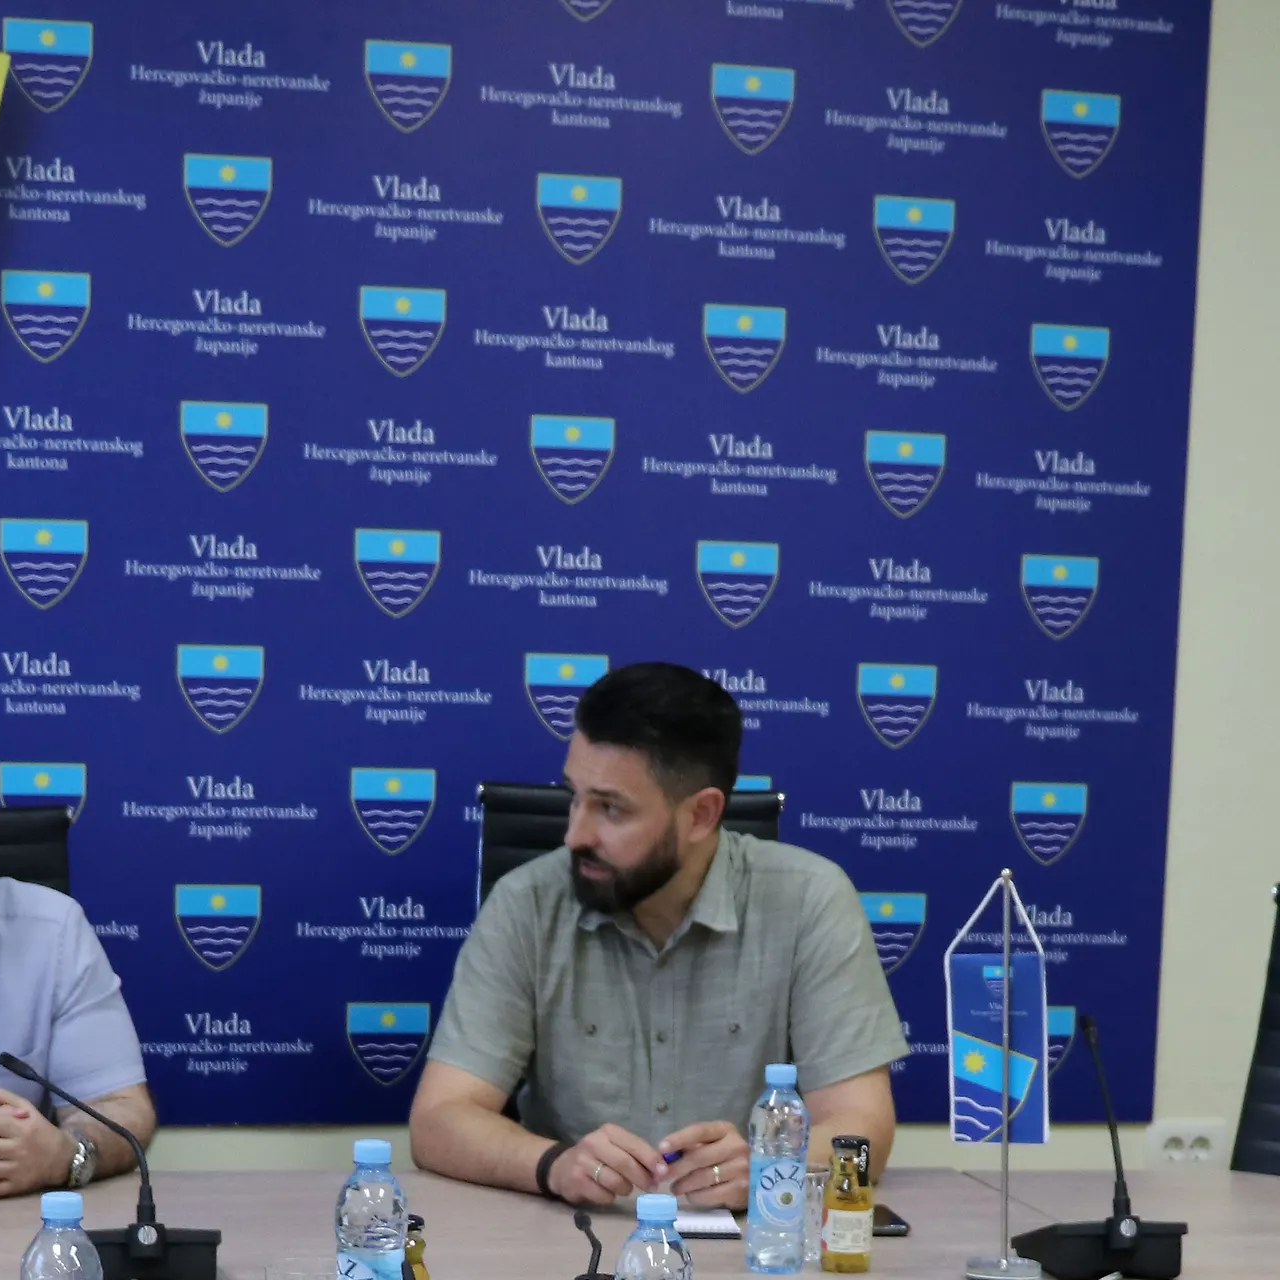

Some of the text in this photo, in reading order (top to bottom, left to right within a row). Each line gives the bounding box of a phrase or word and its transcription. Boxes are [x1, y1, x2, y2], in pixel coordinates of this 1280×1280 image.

[727, 0, 784, 20] kantona
[197, 41, 265, 67] Vlada
[131, 65, 330, 91] Hercegovačko-neretvanske
[549, 63, 615, 90] Vlada
[199, 89, 262, 109] županije
[481, 86, 682, 118] Hercegovačko-neretvanskog
[886, 88, 949, 114] Vlada
[552, 109, 610, 128] kantona
[825, 110, 1007, 137] Hercegovačko-neretvanske
[887, 134, 945, 154] županije
[7, 156, 75, 183] Vlada
[372, 175, 440, 201] Vlada
[9, 204, 70, 222] kantona
[308, 199, 503, 224] Hercegovačko-neretvanske
[716, 195, 781, 222] Vlada
[375, 222, 437, 242] županije
[649, 218, 845, 249] Hercegovačko-neretvanskog
[1045, 218, 1106, 244] Vlada
[718, 240, 775, 259] kantona
[986, 240, 1162, 266] Hercegovačko-neretvanske
[1046, 264, 1101, 282] županije
[192, 289, 262, 315] Vlada
[128, 314, 326, 338] Hercegovačko-neretvanske
[542, 306, 609, 332] Vlada
[196, 337, 258, 357] županije
[474, 329, 675, 358] Hercegovačko-neretvanskog
[877, 324, 940, 350] Vlada
[545, 351, 603, 369] kantona
[816, 347, 997, 372] Hercegovačko-neretvanske
[878, 370, 936, 389] županije
[3, 406, 73, 432] Vlada
[368, 419, 435, 444] Vlada
[304, 443, 498, 466] Hercegovačko-neretvanske
[708, 433, 773, 459] Vlada
[7, 452, 68, 470] kantona
[642, 457, 837, 484] Hercegovačko-neretvanskog
[1035, 450, 1095, 475] Vlada
[370, 466, 431, 486] županije
[711, 478, 767, 496] kantona
[976, 472, 1150, 496] Hercegovačko-neretvanske
[1036, 495, 1091, 513] županije
[190, 534, 258, 560] Vlada
[536, 545, 602, 570] Vlada
[125, 560, 321, 581] Hercegovačko-neretvanske
[469, 569, 668, 595] Hercegovačko-neretvanskog
[869, 558, 931, 583] Vlada
[192, 581, 254, 601] županije
[539, 590, 597, 607] kantona
[809, 581, 988, 603] Hercegovačko-neretvanske
[870, 603, 927, 622] županije
[1, 651, 71, 676] Vlada
[363, 659, 430, 684] Vlada
[300, 684, 492, 705] Hercegovačko-neretvanske
[1025, 679, 1084, 703] Vlada
[6, 697, 66, 715] kantona
[365, 705, 426, 724] županije
[967, 702, 1139, 723] Hercegovačko-neretvanske
[1025, 724, 1080, 740] županije
[186, 775, 255, 800] Vlada
[123, 801, 318, 821] Hercegovačko-neretvanske
[860, 788, 922, 812] Vlada
[189, 822, 251, 841] županije
[800, 813, 978, 832] Hercegovačko-neretvanske
[861, 833, 917, 850] županije
[359, 896, 425, 920] Vlada
[361, 941, 421, 960] županije
[185, 1012, 251, 1035] Vlada
[188, 1058, 248, 1075] županije
